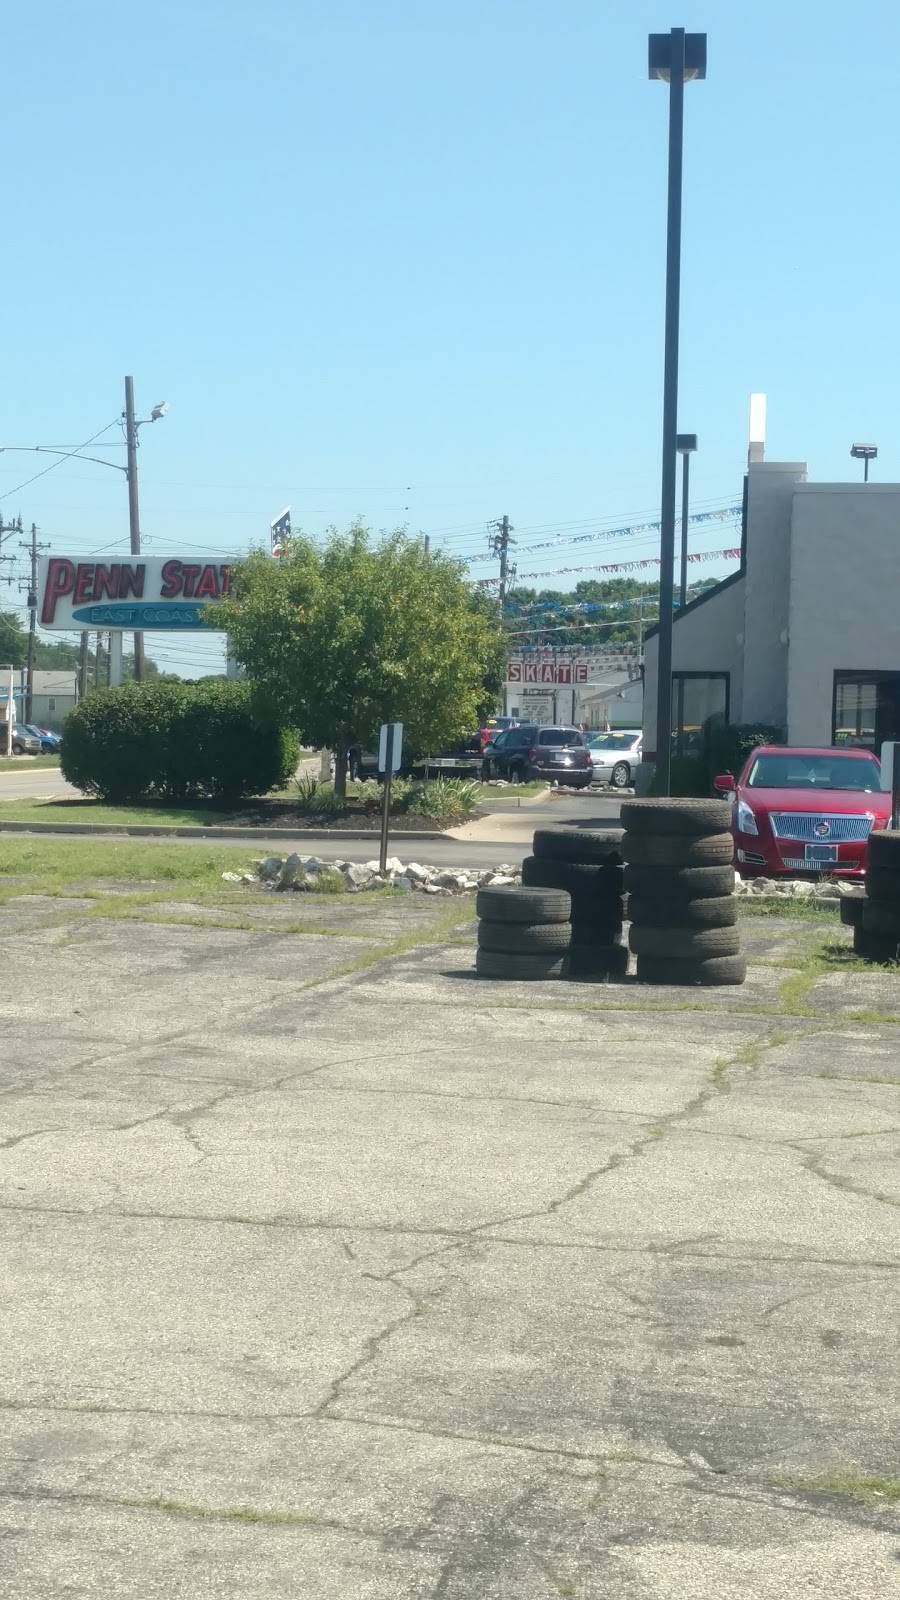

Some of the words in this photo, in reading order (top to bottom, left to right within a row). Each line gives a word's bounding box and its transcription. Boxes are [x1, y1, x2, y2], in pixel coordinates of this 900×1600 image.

[41, 558, 146, 624] PENN
[160, 559, 244, 600] STAT
[91, 608, 137, 622] EAST
[143, 608, 198, 622] COAS
[508, 664, 587, 683] SKATE
